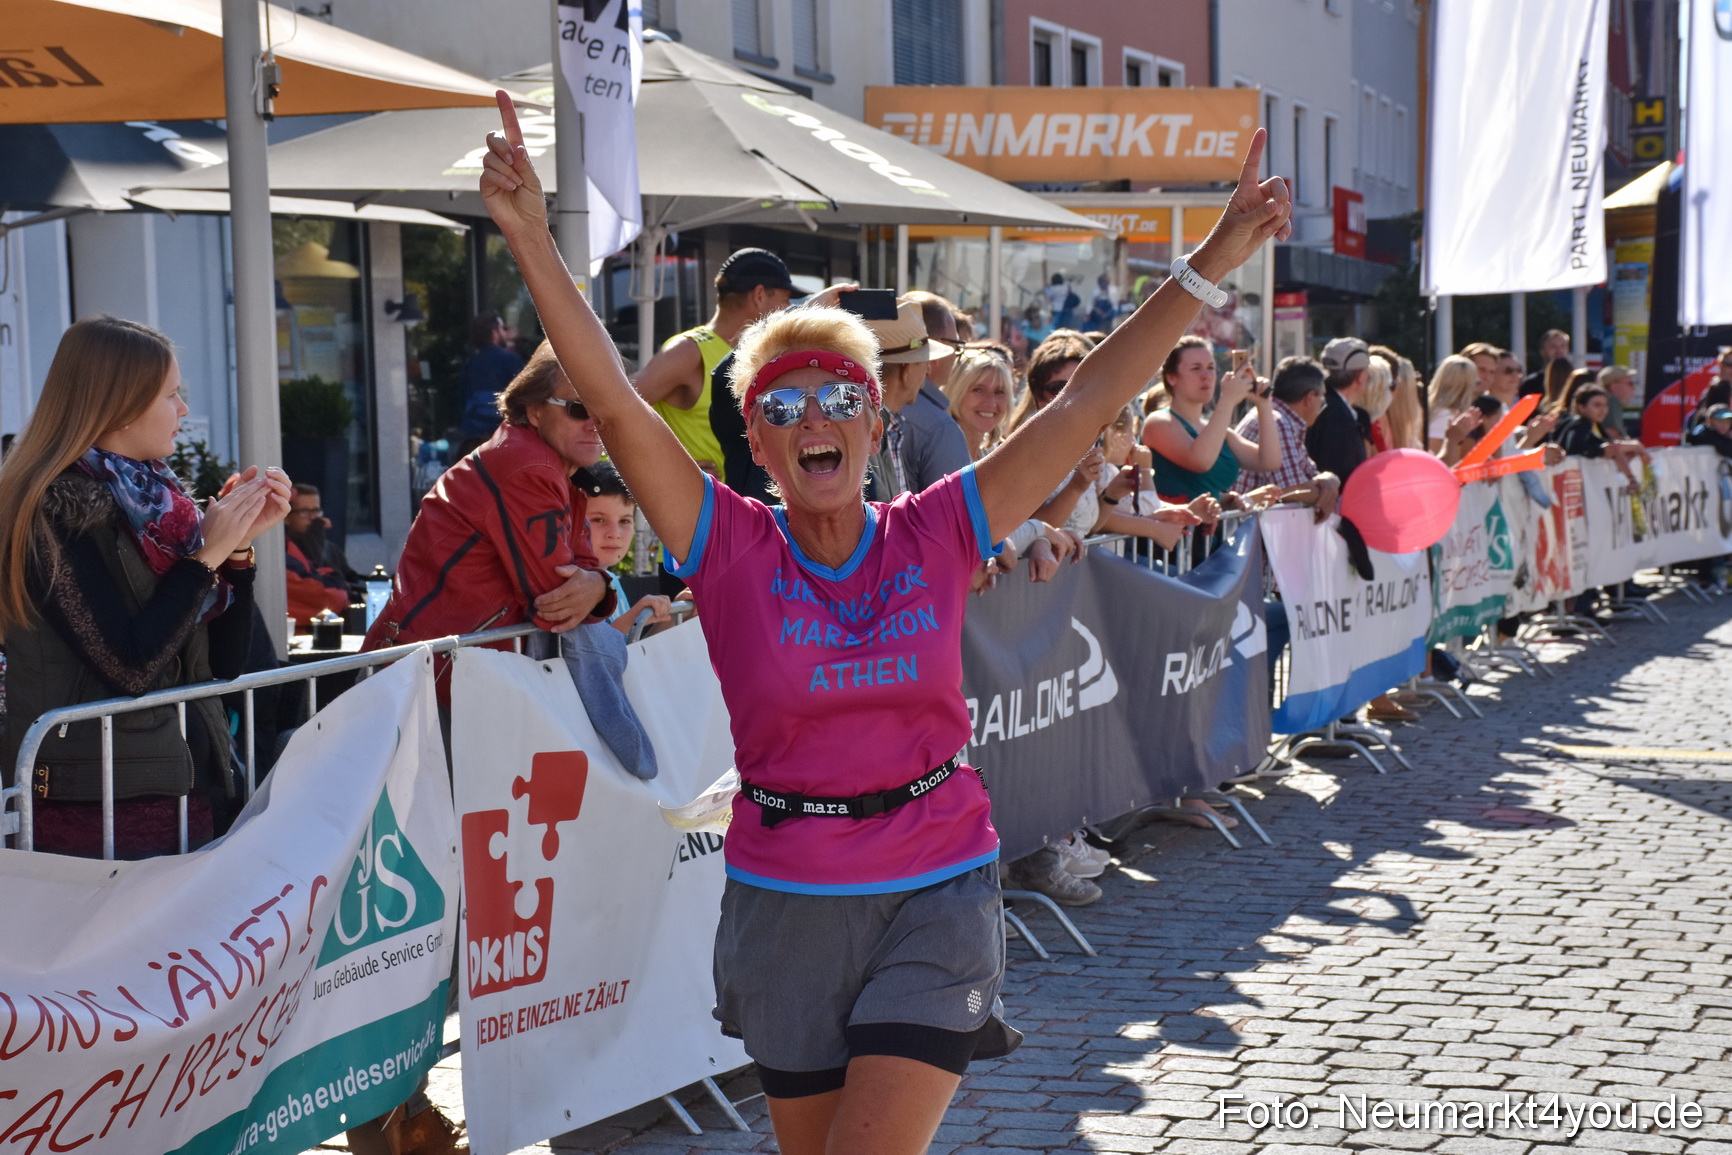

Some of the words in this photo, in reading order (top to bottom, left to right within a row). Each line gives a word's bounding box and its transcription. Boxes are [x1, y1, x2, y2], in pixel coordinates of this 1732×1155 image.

[1570, 58, 1590, 190] NEUMARKT
[879, 564, 929, 604] FOR
[779, 604, 940, 649] MARATHON
[809, 654, 918, 692] ATHEN
[803, 802, 849, 814] mara
[909, 763, 951, 798] thoni
[313, 980, 332, 1001] Jura
[333, 955, 380, 989] Gebäude
[381, 942, 424, 970] Service
[470, 925, 544, 992] DKMS
[476, 1011, 514, 1051] JEDER
[517, 991, 583, 1034] EINZELNE
[584, 979, 630, 1014] ZÄHLT
